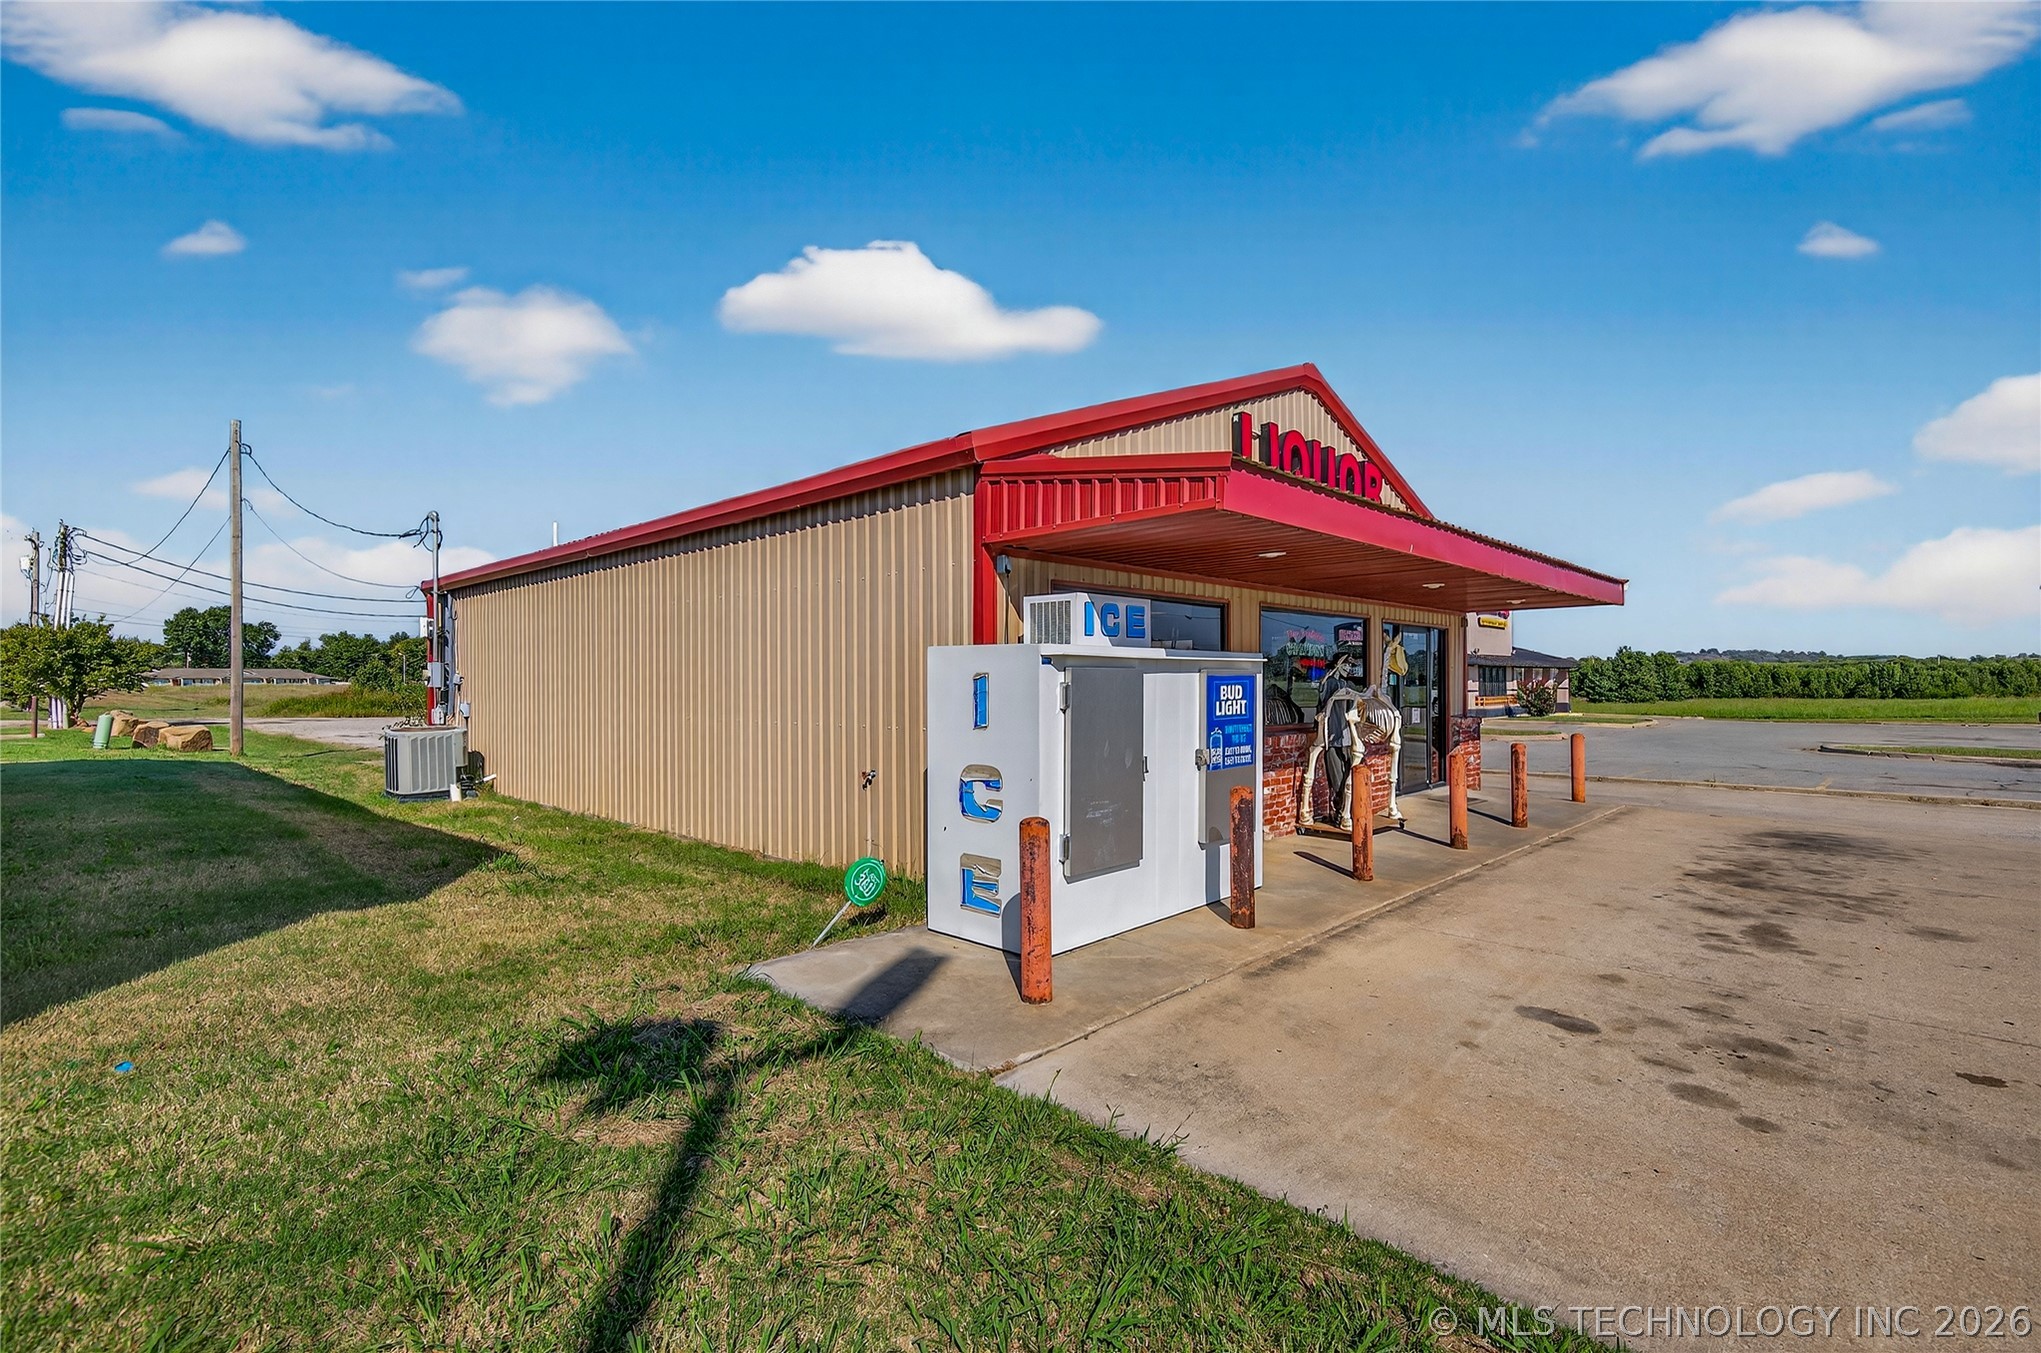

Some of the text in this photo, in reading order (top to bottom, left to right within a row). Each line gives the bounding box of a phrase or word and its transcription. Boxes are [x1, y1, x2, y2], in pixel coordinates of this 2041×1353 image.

[1083, 600, 1146, 639] ICE
[1220, 684, 1243, 701] BUD
[1215, 699, 1247, 717] LIGHT
